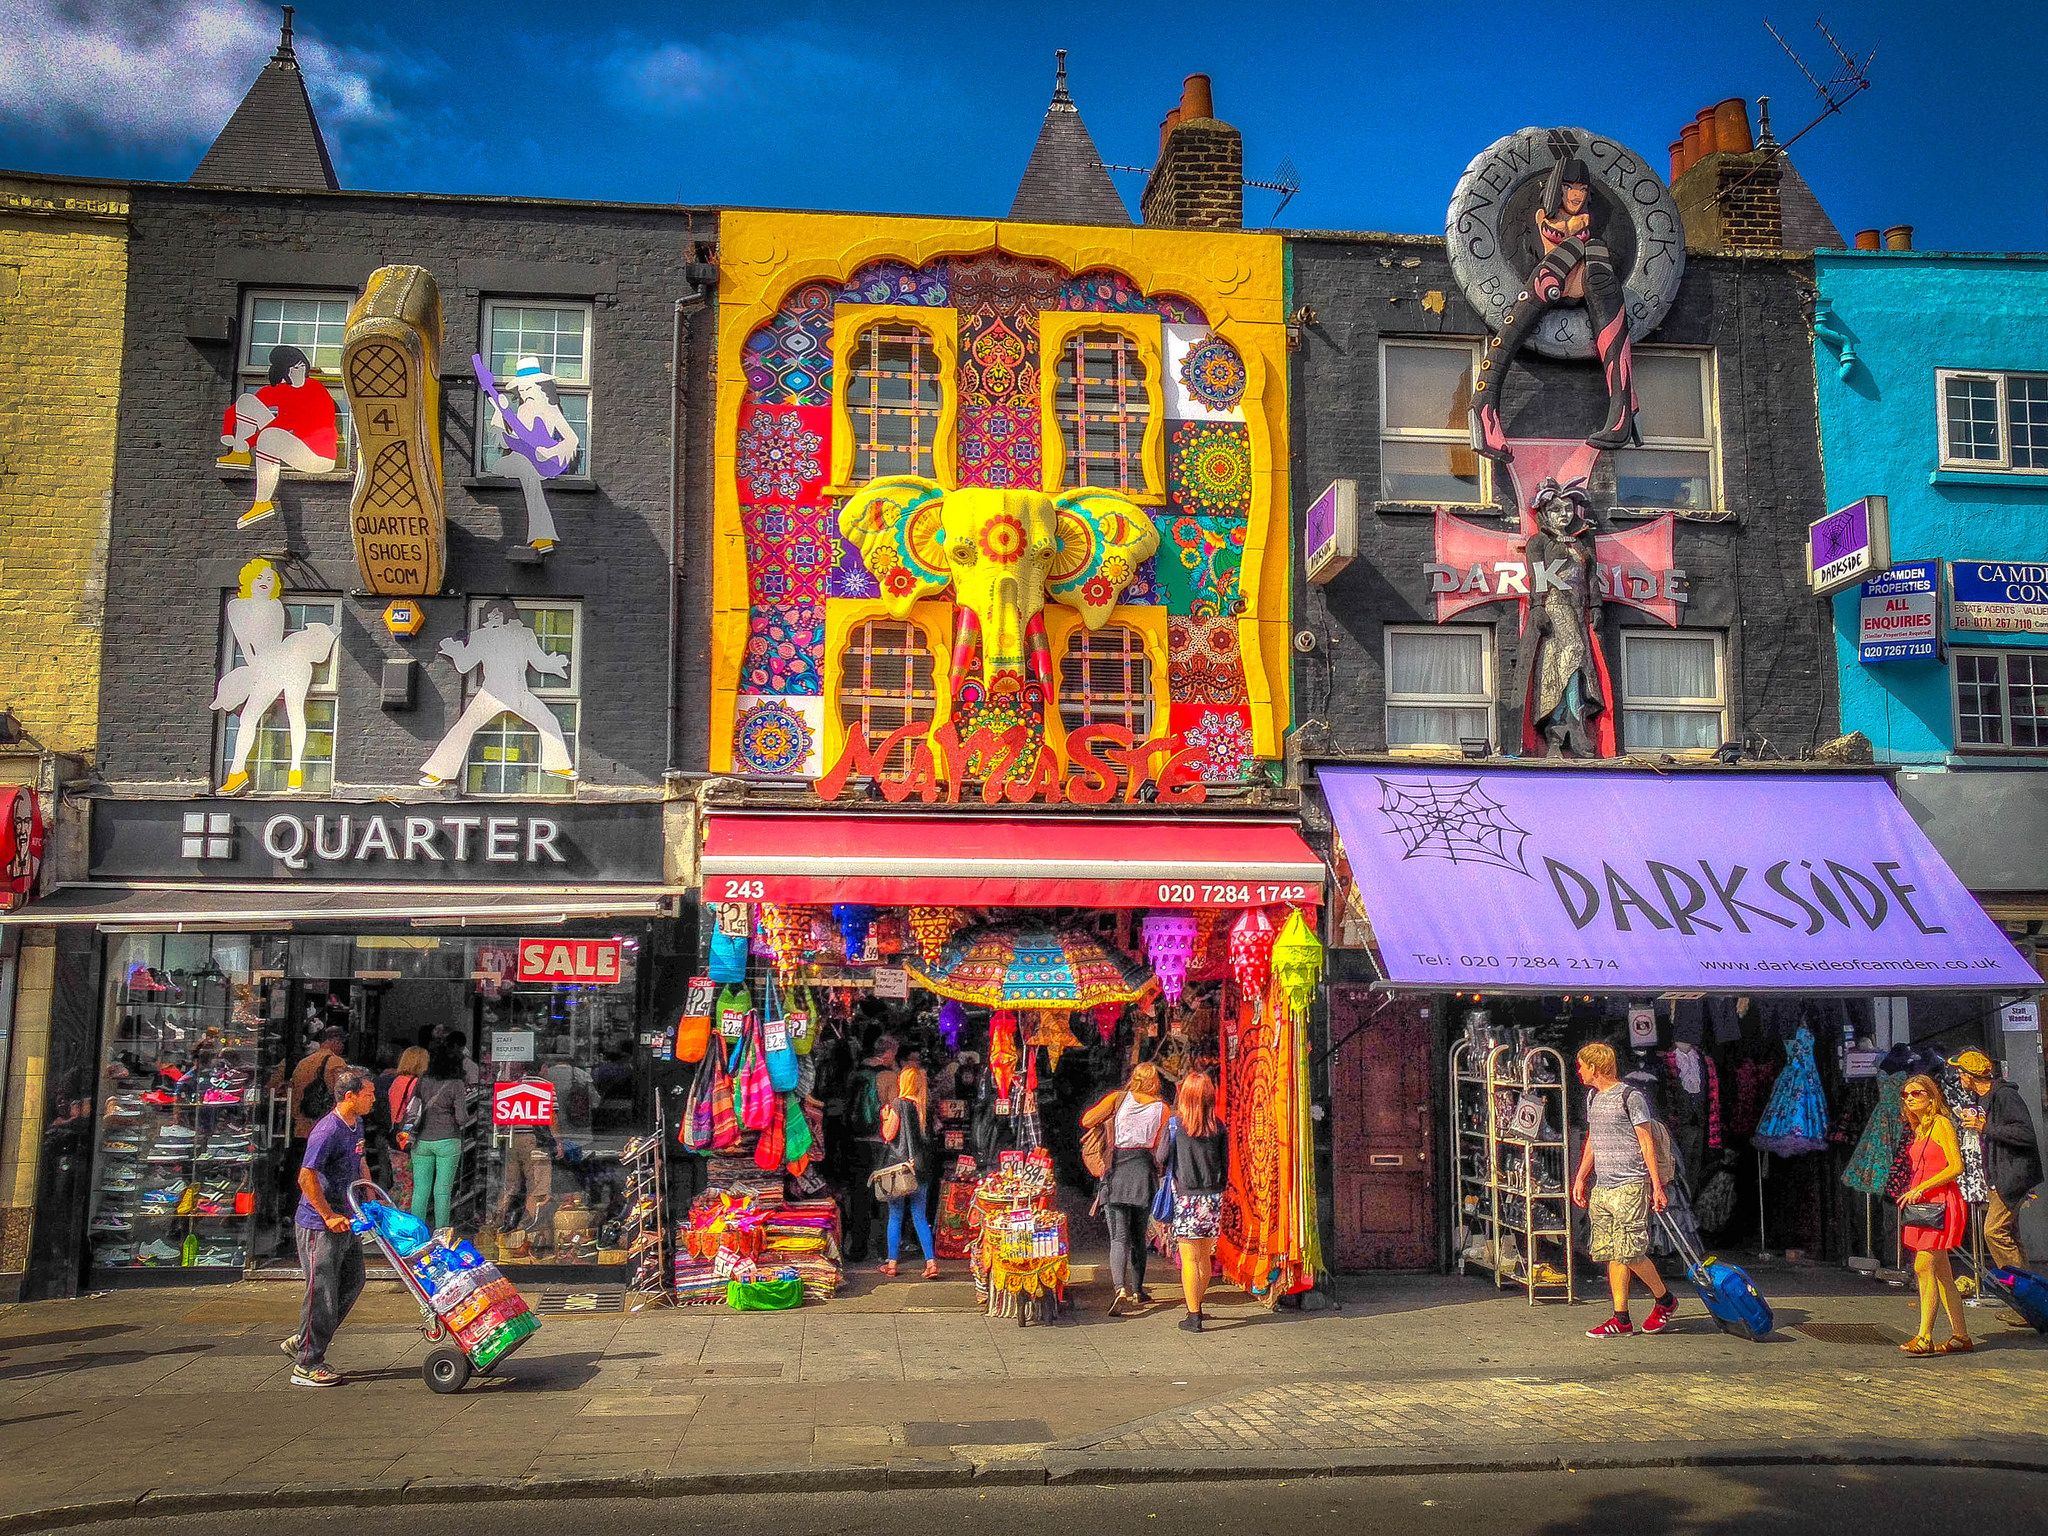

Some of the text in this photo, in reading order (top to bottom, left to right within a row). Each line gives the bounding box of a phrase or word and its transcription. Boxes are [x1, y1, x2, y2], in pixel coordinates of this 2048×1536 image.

[1457, 136, 1676, 276] NEW ROCK
[1554, 317, 1574, 344] &
[372, 408, 394, 432] 4
[356, 516, 429, 536] QUARTER
[369, 543, 421, 561] SHOES
[1423, 558, 1572, 595] DARK
[1883, 568, 1925, 582] CAMDEN
[1868, 580, 1931, 595] PROPERTIES
[1886, 598, 1910, 612] ALL
[1954, 604, 1982, 614] ESTATE
[1985, 605, 2015, 615] AGENTS
[392, 611, 409, 621] ADT
[1864, 614, 1932, 630] ENQUIRIES
[1973, 617, 1992, 628] 0171
[1996, 617, 2011, 629] 267
[2014, 618, 2032, 630] 7110
[1864, 643, 1932, 658] 020 7267 7110
[262, 812, 566, 870] QUARTER
[725, 880, 1306, 903] 243 020 7284 1742
[523, 944, 616, 977] SALE
[1412, 953, 1619, 970] Tel: 020 7284 2174
[1700, 957, 2001, 972] www.darksideofcamden.co.uk
[496, 1101, 550, 1120] SALE
